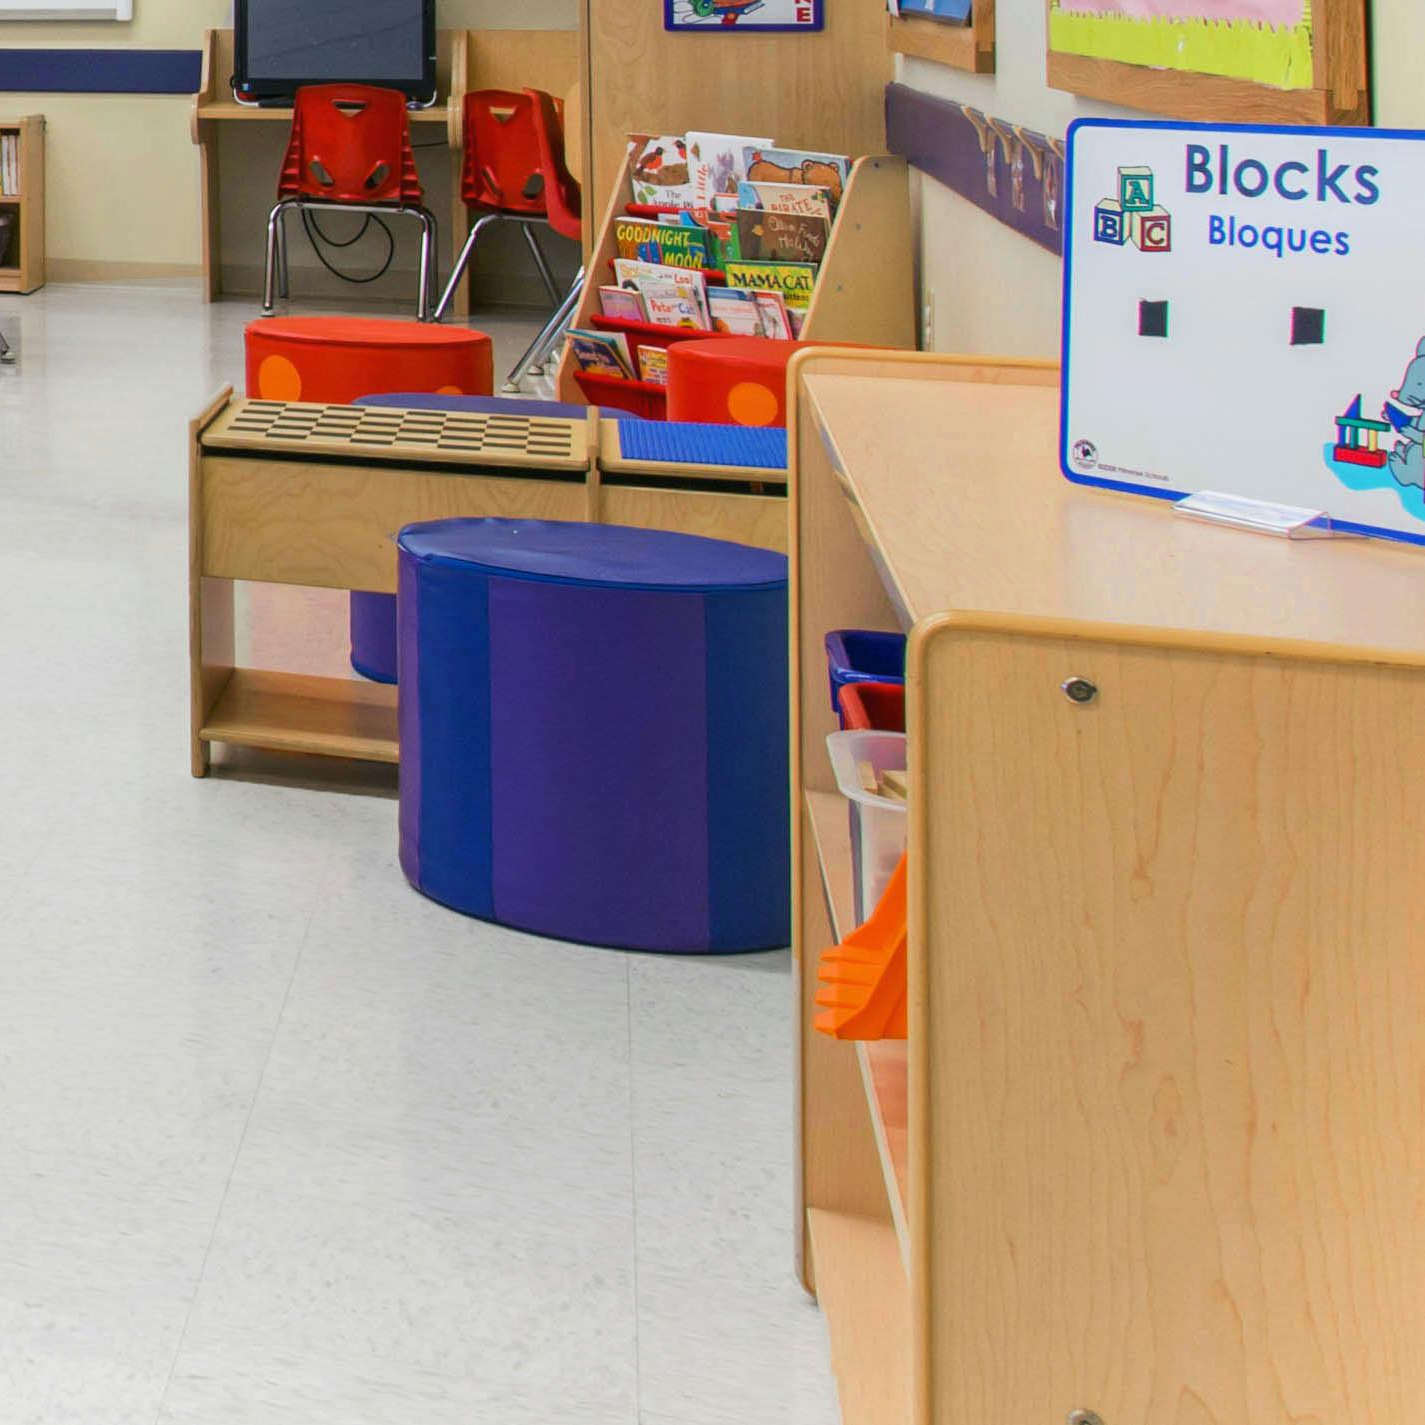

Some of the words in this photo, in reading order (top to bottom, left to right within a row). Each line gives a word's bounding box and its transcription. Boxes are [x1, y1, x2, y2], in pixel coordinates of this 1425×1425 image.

[1185, 143, 1381, 206] Blocks
[664, 189, 681, 199] The
[1128, 180, 1150, 207] A
[616, 224, 691, 247] GOODNIGHT
[1100, 215, 1118, 240] B
[1146, 222, 1166, 246] C
[1208, 214, 1351, 259] Bloques
[664, 251, 703, 269] MOON
[733, 272, 782, 289] MAMA
[783, 274, 810, 290] CAT
